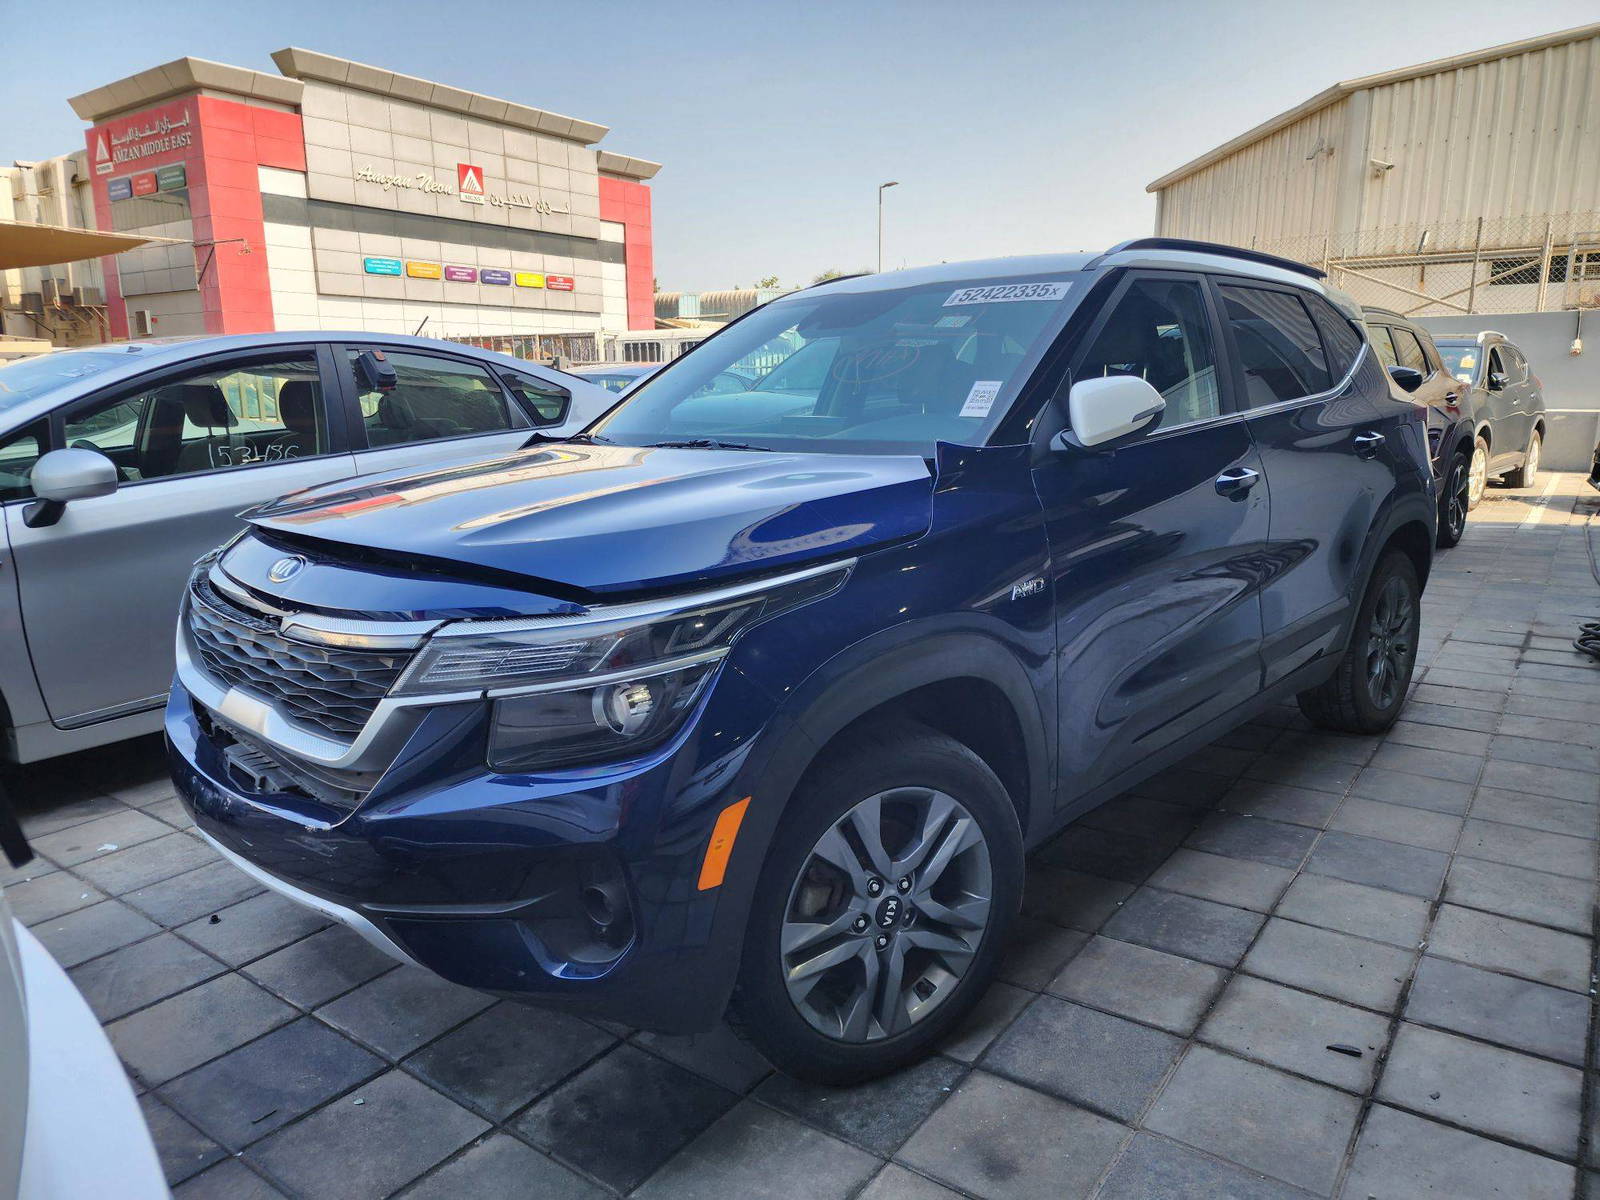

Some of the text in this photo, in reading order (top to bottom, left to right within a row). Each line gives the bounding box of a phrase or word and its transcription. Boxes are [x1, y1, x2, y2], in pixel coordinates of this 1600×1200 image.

[112, 132, 192, 165] AMZAN MIDDLE EAST
[356, 165, 453, 195] Amzan Neon
[1011, 577, 1045, 601] AWD
[882, 900, 898, 926] KIA
